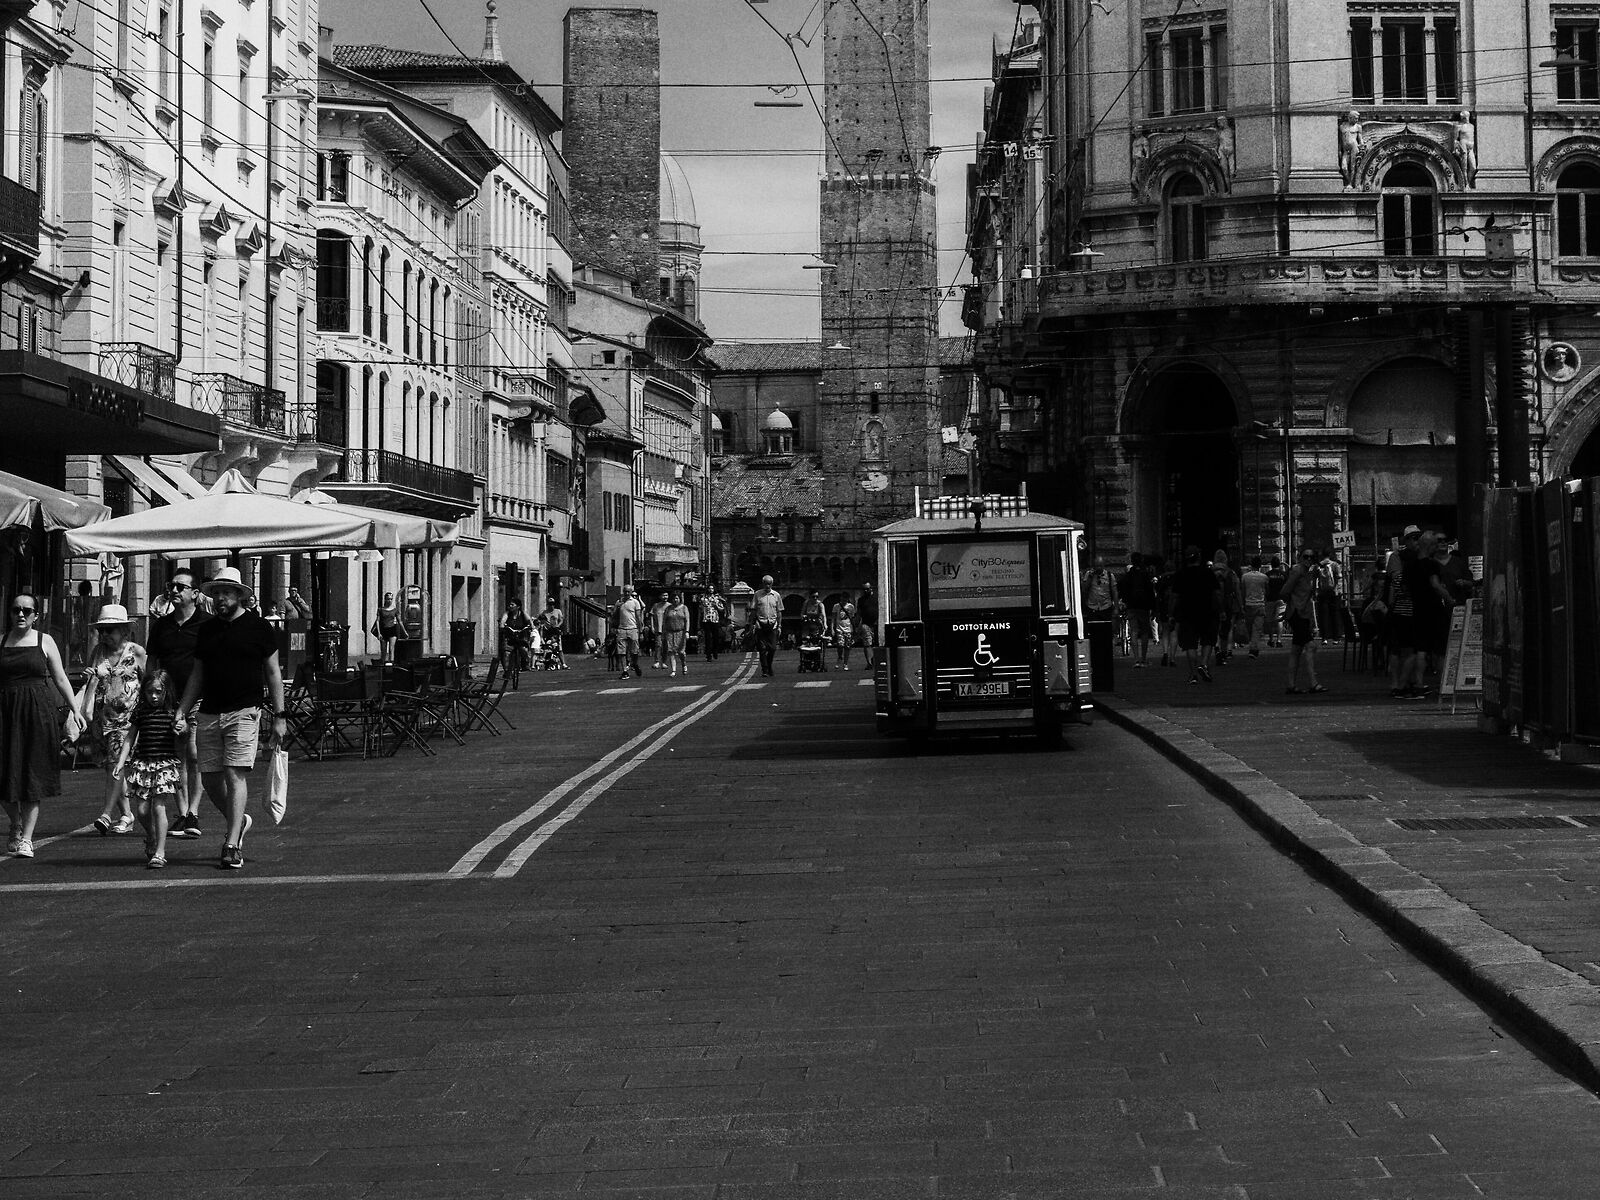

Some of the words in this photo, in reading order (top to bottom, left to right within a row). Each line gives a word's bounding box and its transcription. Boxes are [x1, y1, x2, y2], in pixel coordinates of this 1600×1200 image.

[1004, 146, 1017, 157] 14
[1024, 149, 1036, 159] 15
[897, 154, 910, 163] 13
[1335, 535, 1353, 544] TAXI
[930, 561, 961, 580] City
[952, 622, 1011, 632] DOTTOTRAINS
[898, 627, 909, 643] 4
[960, 683, 973, 696] XA
[975, 682, 1007, 695] 299EL
